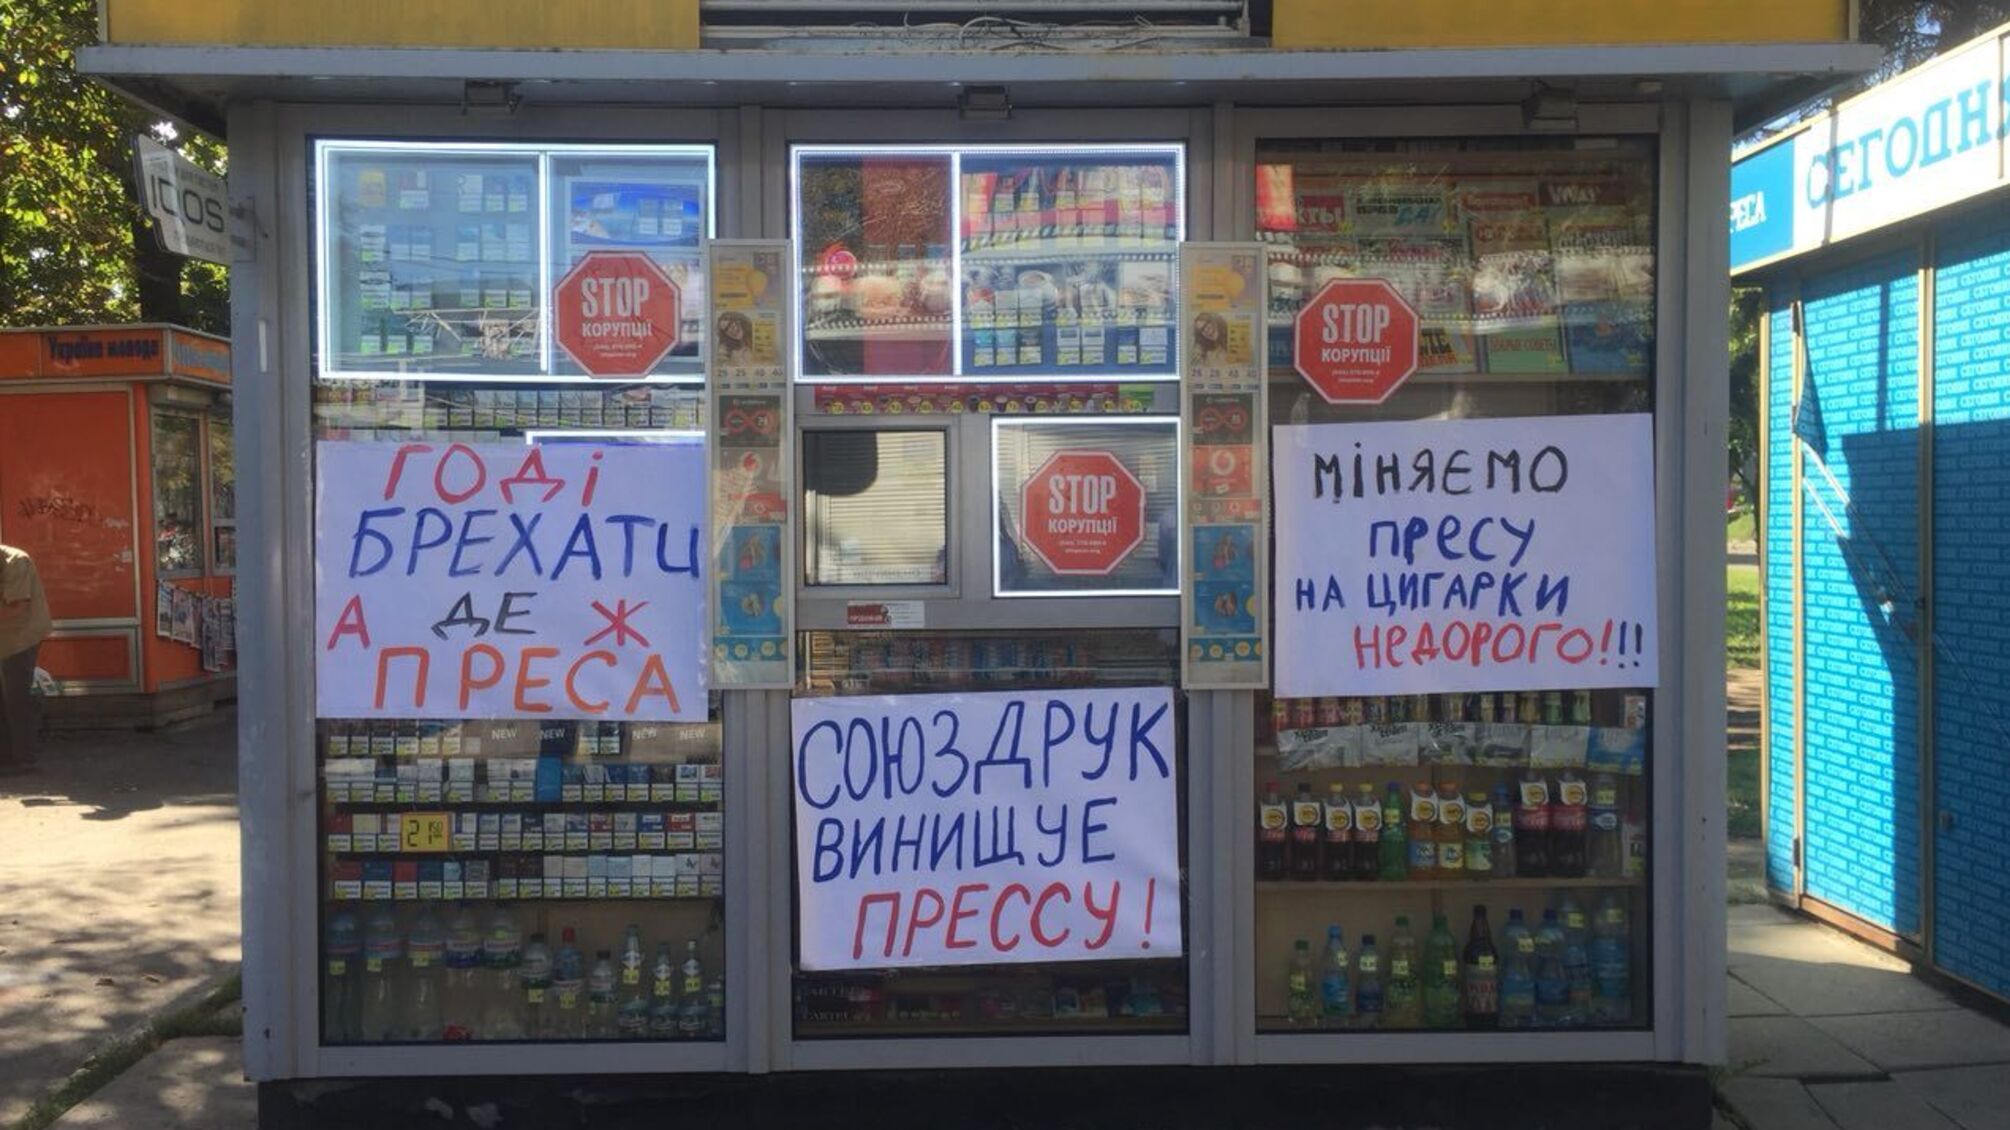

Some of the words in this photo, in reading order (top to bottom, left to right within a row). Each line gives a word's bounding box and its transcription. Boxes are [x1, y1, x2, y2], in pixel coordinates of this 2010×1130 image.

[1730, 191, 1766, 232] РЕСА
[581, 276, 650, 318] STOP
[582, 319, 653, 339] КОРУПЦІЇ
[1322, 303, 1390, 344] STOP
[1321, 345, 1391, 365] КОРУПЦІЇ
[1048, 474, 1116, 514] STOP
[1048, 516, 1118, 536] КОРУПЦІЇ
[1296, 573, 1346, 612] НА
[1366, 570, 1570, 617] ЦИГАРКИ
[326, 593, 371, 651] А
[430, 591, 539, 641] ДЕ
[583, 598, 650, 648] Ж
[374, 643, 682, 715] ПРЕСА
[491, 728, 517, 741] NEW
[540, 728, 566, 741] NEW
[679, 728, 706, 741] NEW
[812, 796, 1118, 883] ВИНИЩУЕ
